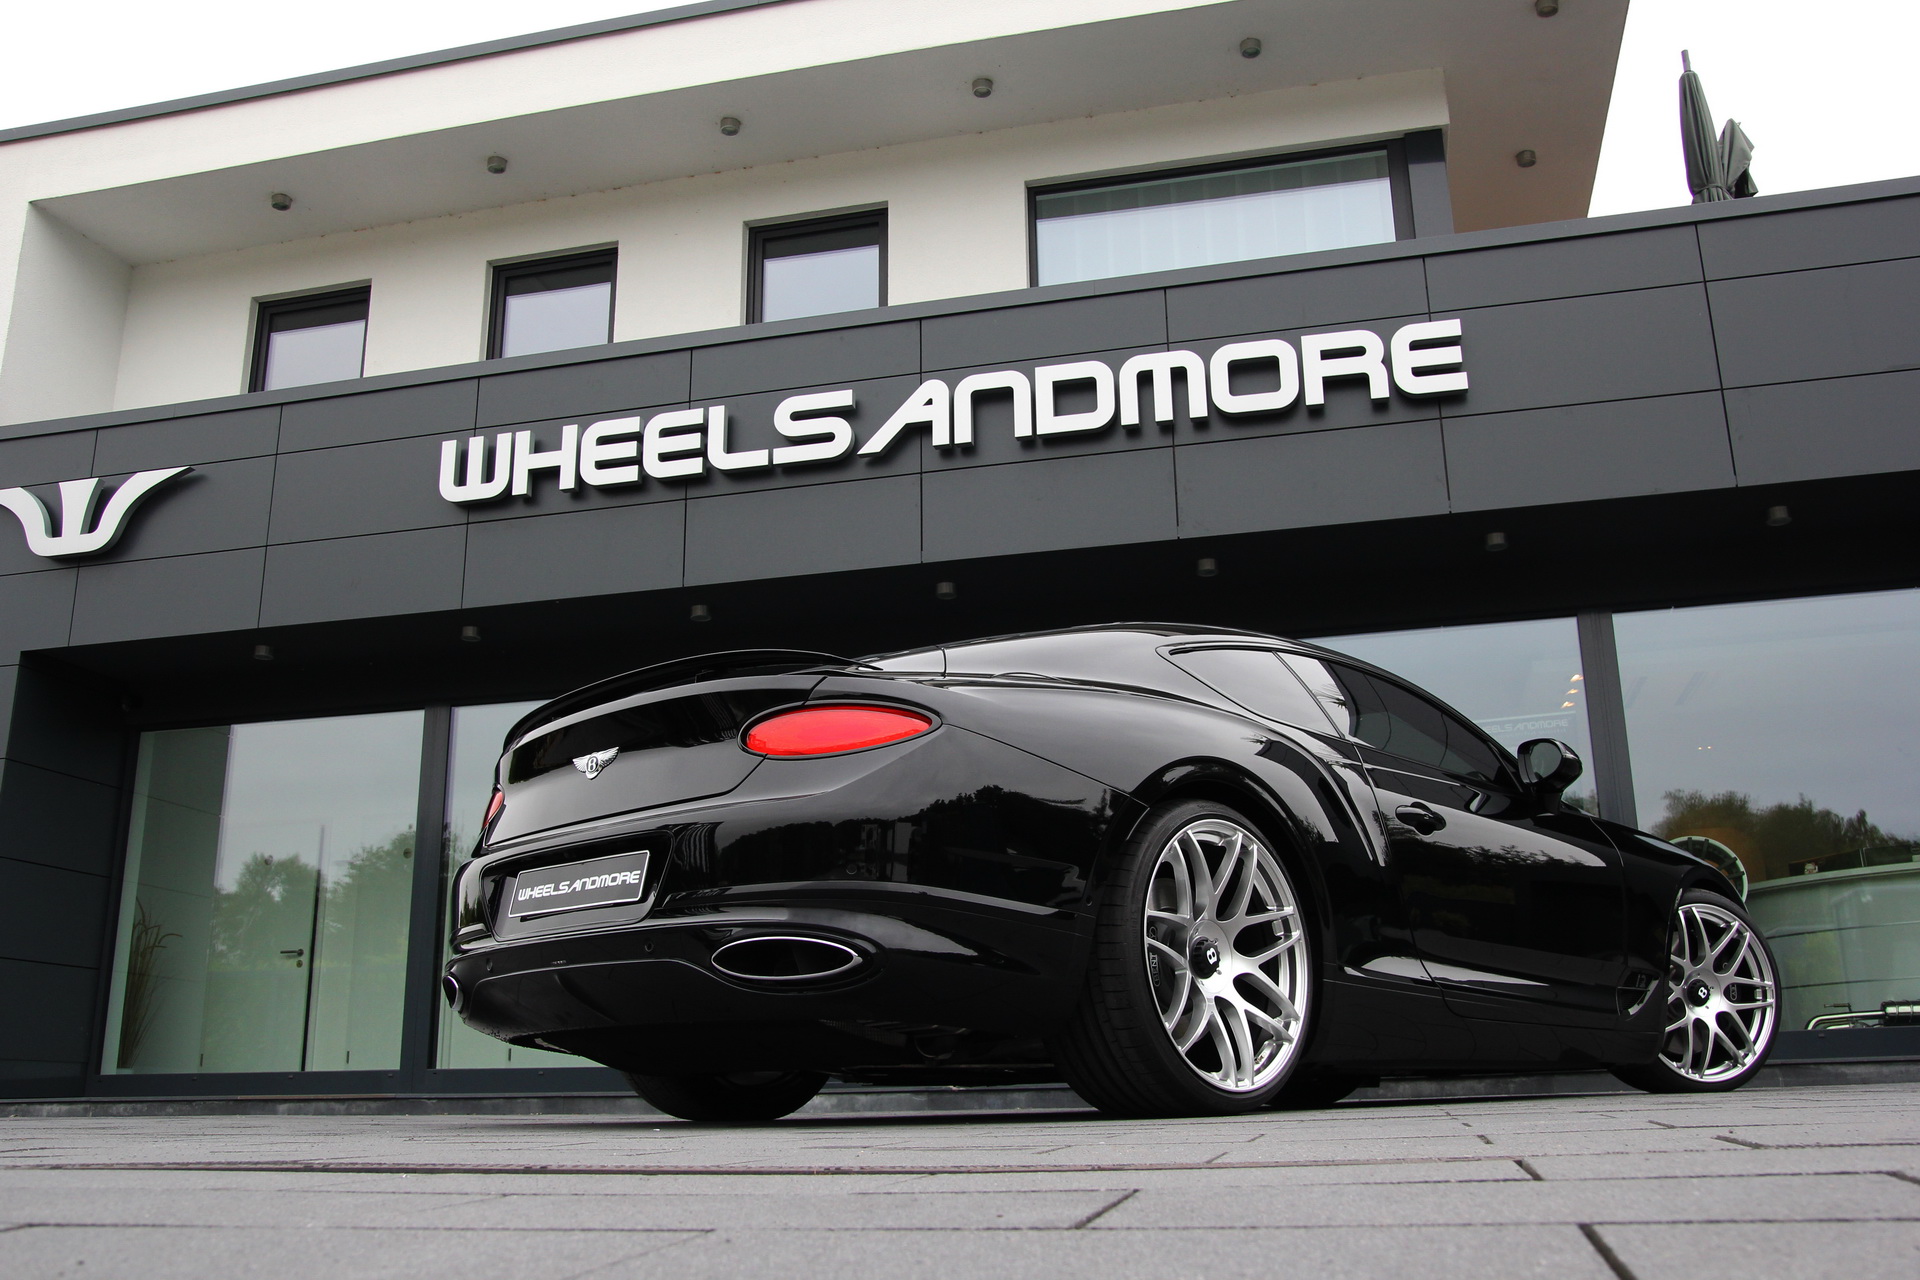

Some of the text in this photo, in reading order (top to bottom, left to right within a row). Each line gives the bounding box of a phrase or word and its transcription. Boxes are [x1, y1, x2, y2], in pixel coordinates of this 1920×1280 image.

[439, 318, 1469, 503] WHEELSANDMORE
[517, 870, 641, 901] WHEELSANDMORE
[1206, 947, 1218, 965] B
[1698, 986, 1708, 999] B
